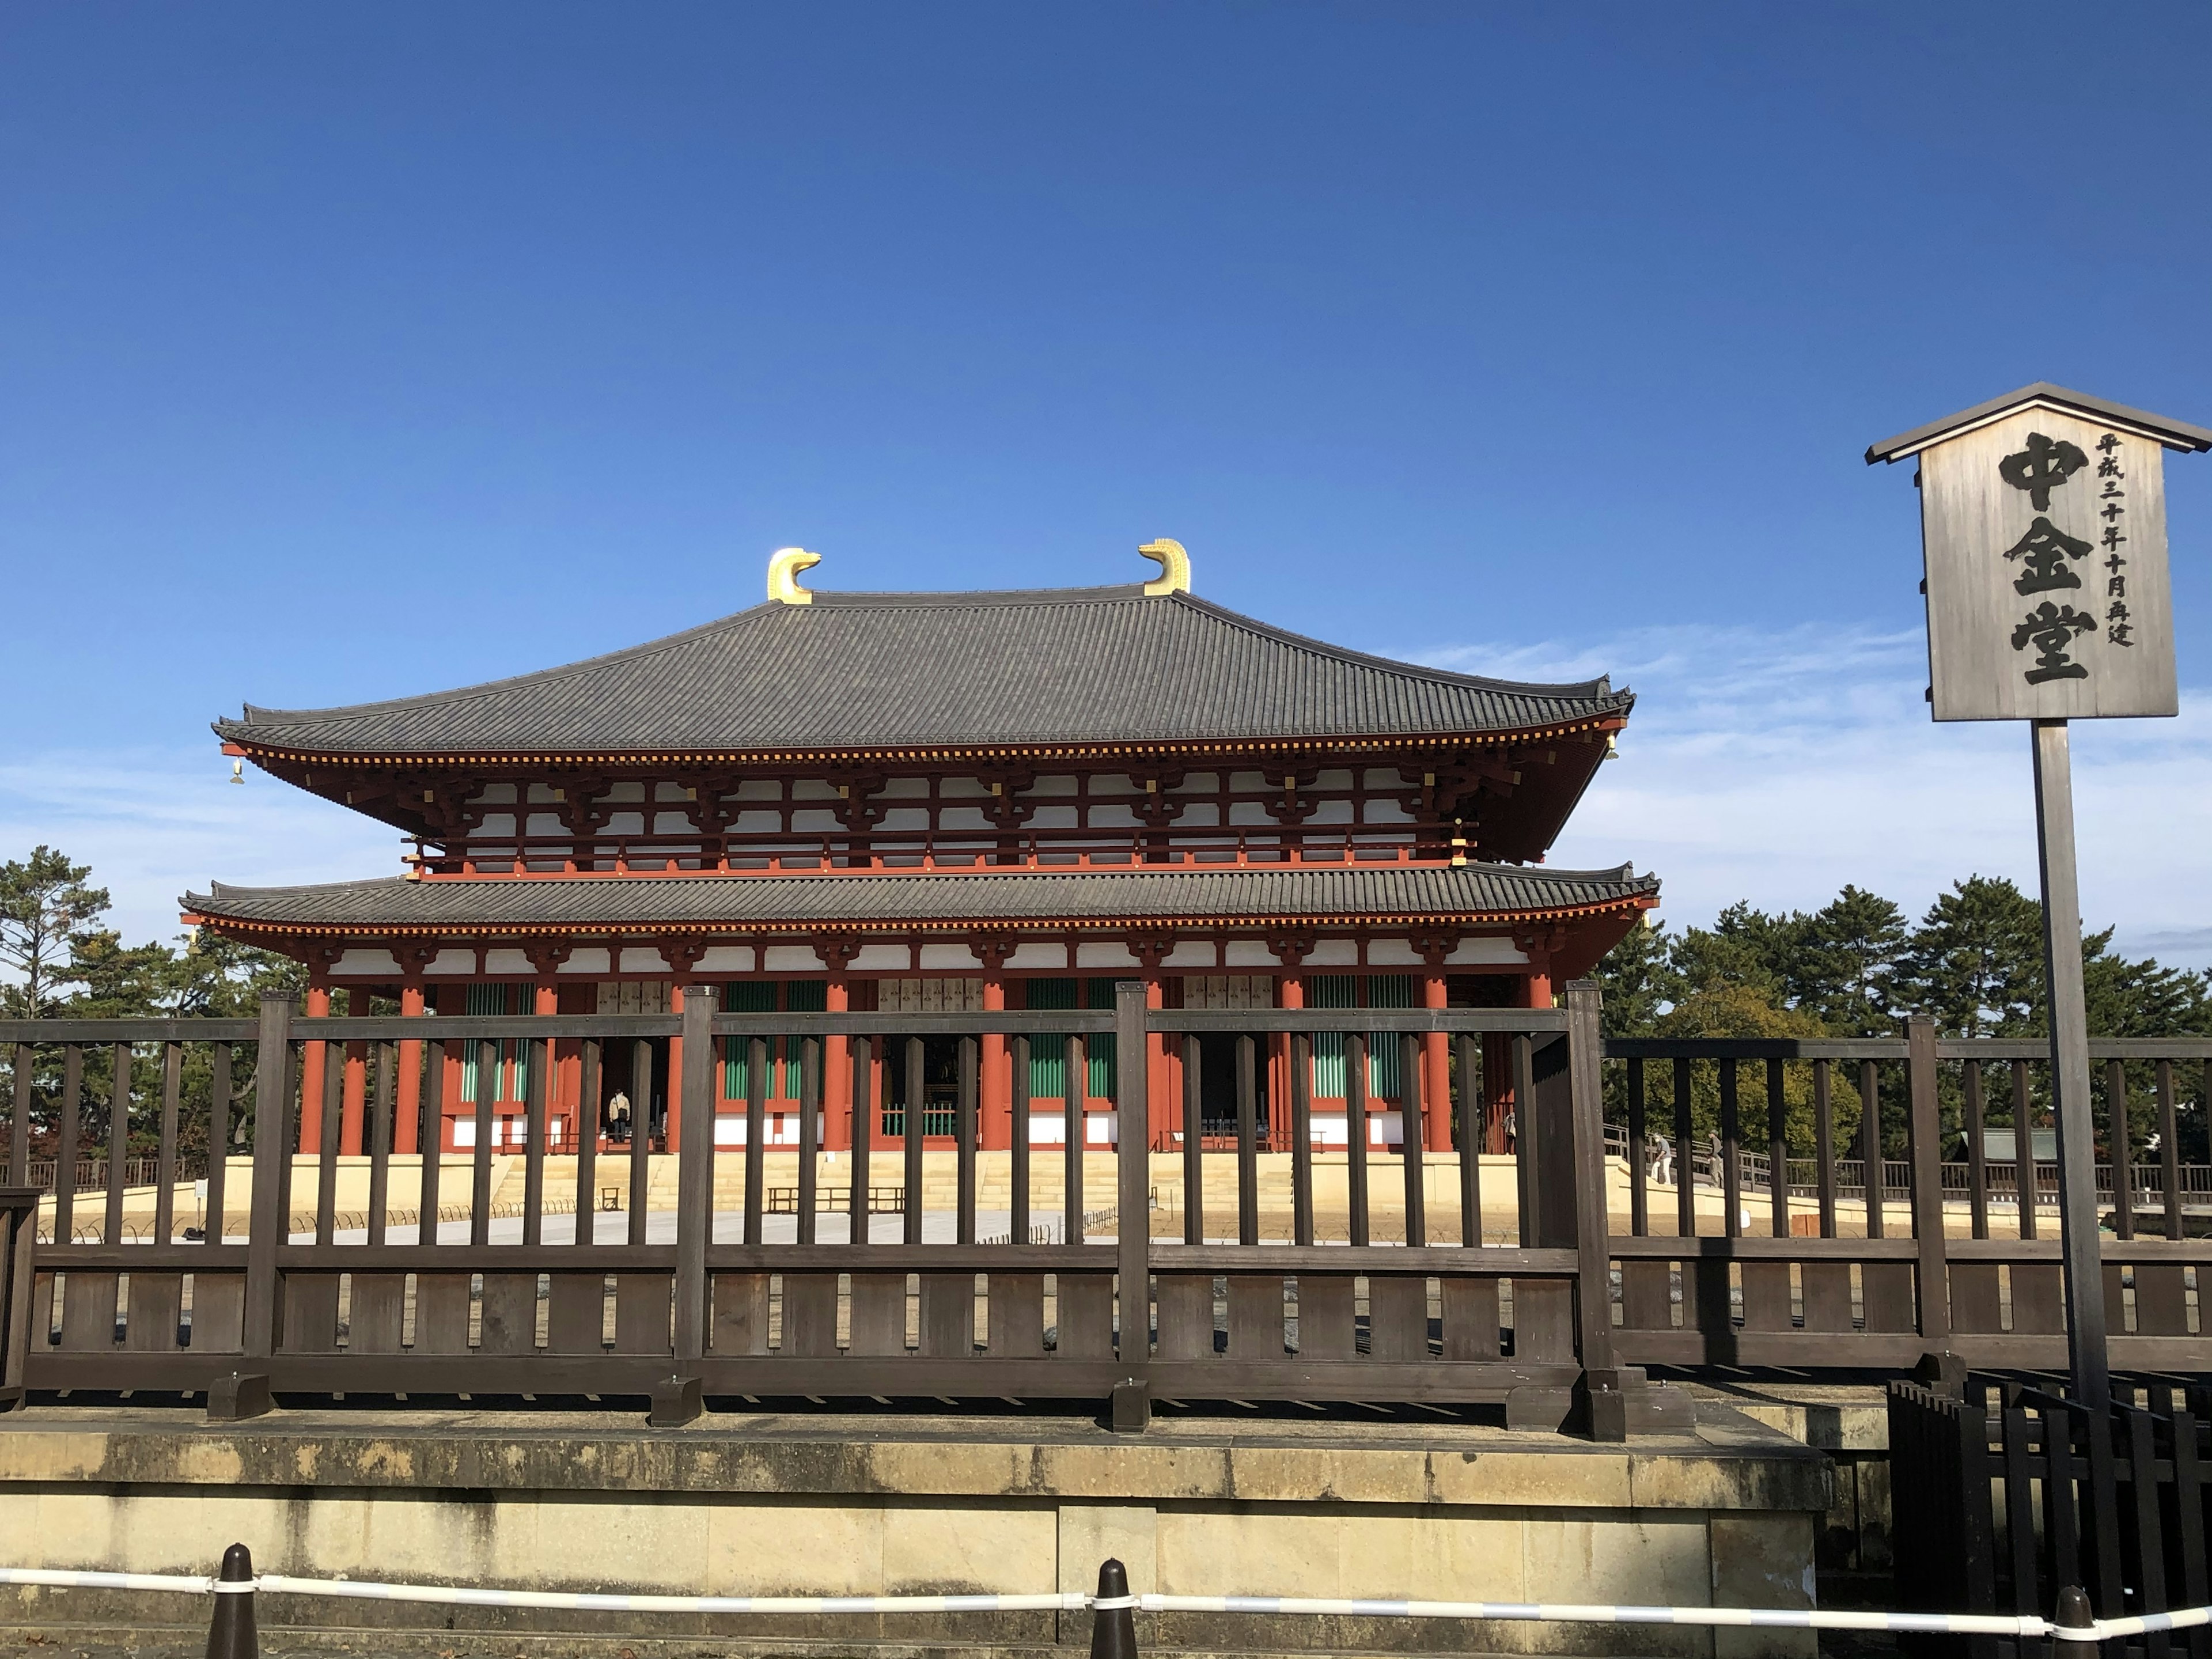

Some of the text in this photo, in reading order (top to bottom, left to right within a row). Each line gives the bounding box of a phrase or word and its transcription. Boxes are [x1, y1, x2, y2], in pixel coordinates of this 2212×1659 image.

[1999, 432, 2097, 685] 中金堂
[2096, 433, 2134, 647] 平成三十年十月再建
